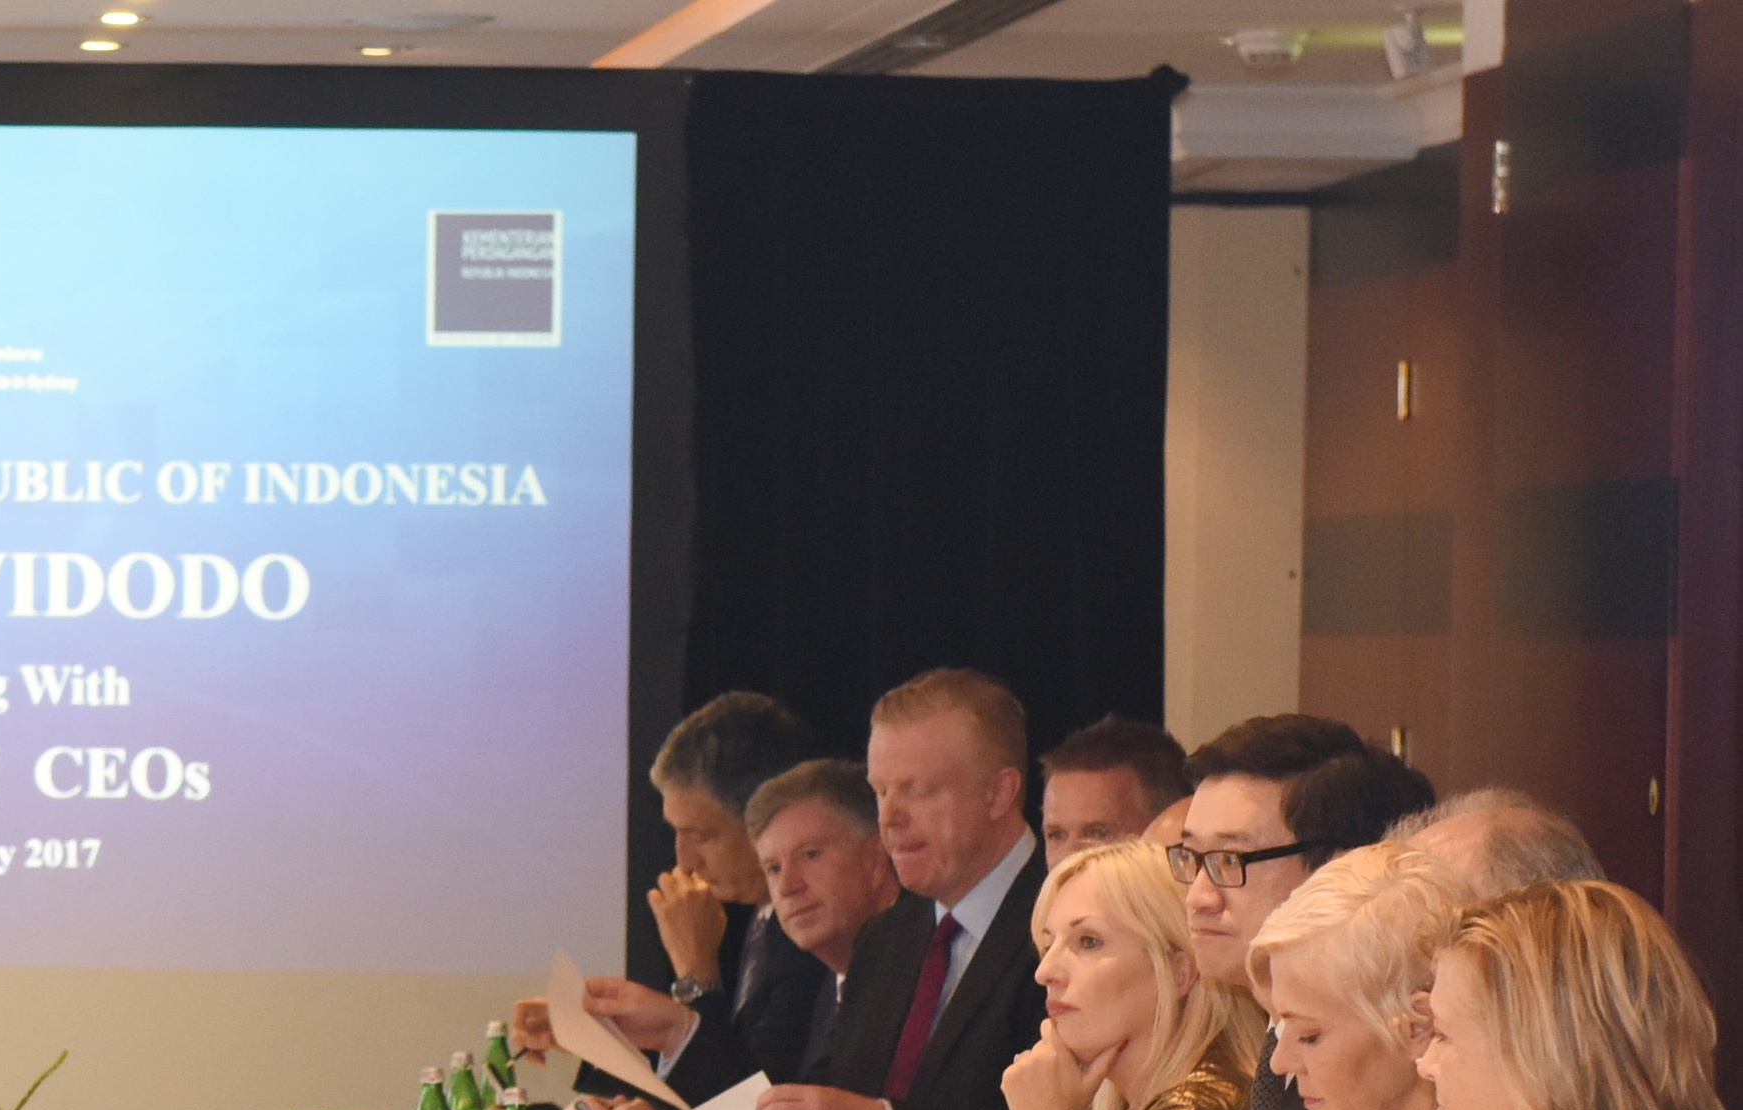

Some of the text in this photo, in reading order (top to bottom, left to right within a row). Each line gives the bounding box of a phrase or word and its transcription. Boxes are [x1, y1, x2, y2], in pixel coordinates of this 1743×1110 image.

[157, 461, 232, 505] OF
[245, 462, 549, 507] INDONESIA
[21, 665, 132, 708] With
[34, 746, 213, 802] CEOs
[25, 838, 103, 870] 2017
